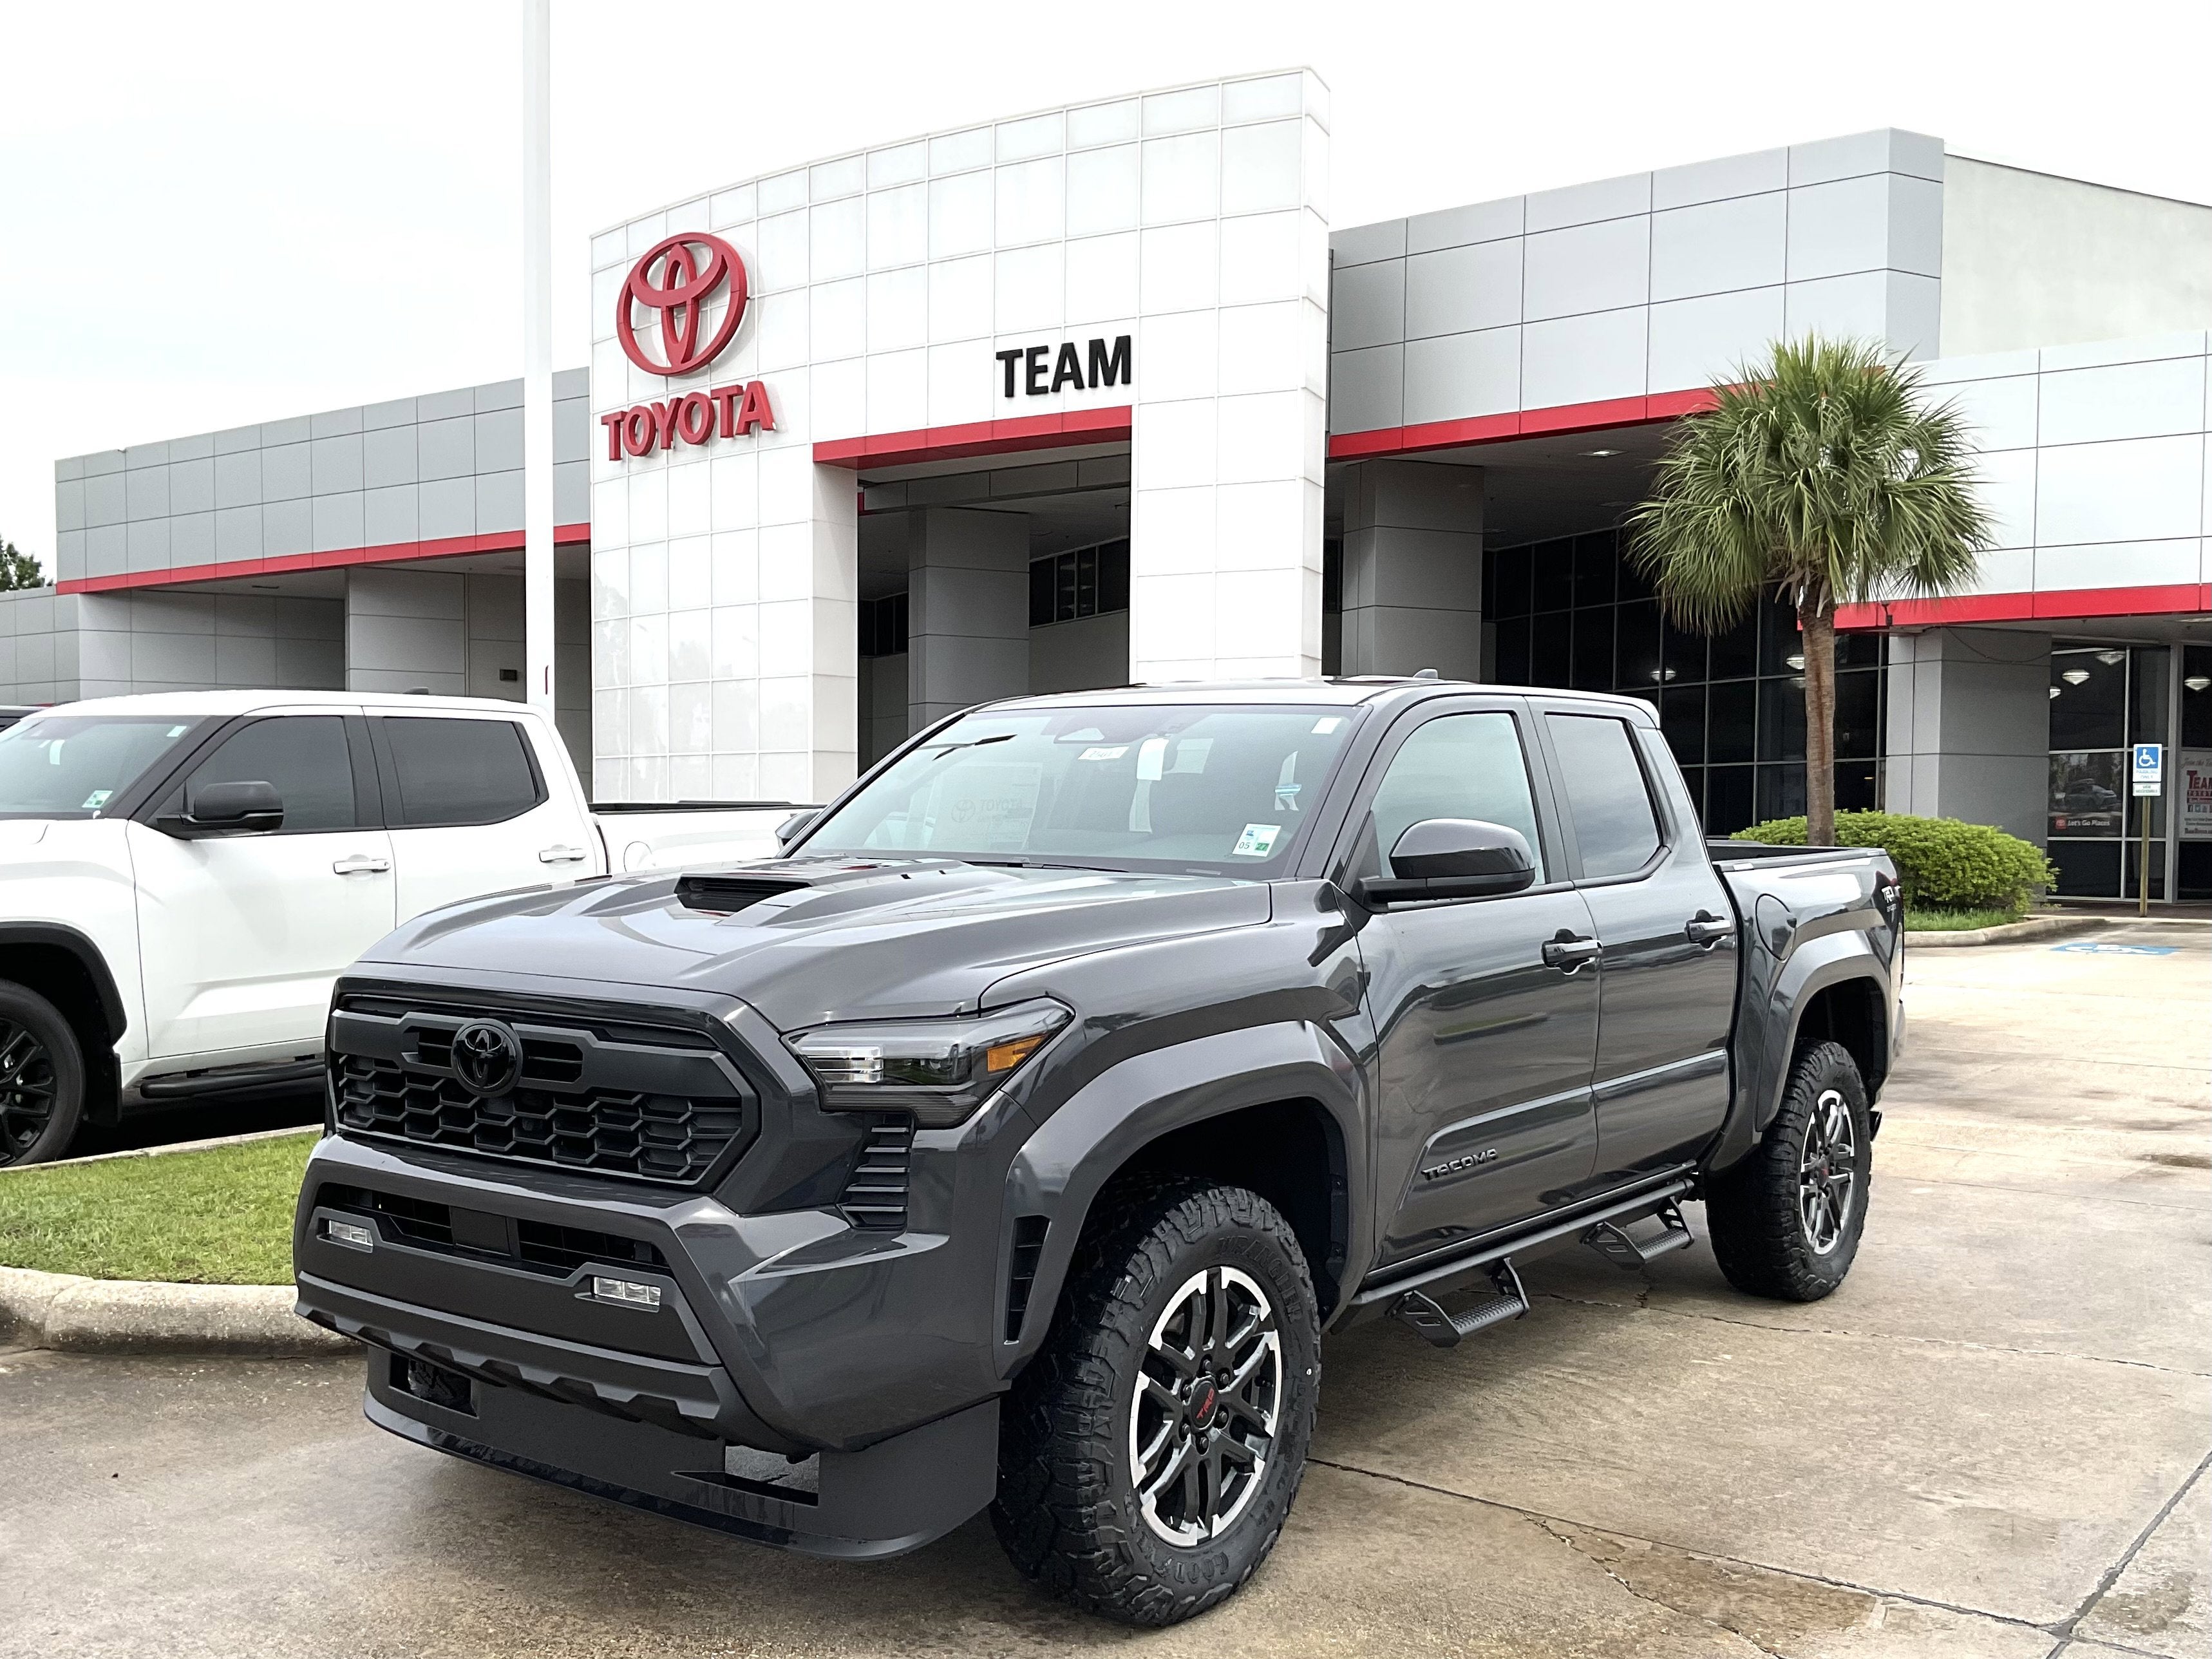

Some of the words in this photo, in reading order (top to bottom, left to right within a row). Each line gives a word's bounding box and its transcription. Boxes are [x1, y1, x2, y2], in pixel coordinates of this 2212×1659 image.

[996, 335, 1131, 397] TEAM
[601, 381, 775, 461] TOYOTA
[1421, 1148, 1498, 1180] TACOMA
[1216, 1235, 1303, 1325] WRANGLER
[1196, 1387, 1215, 1419] TRD
